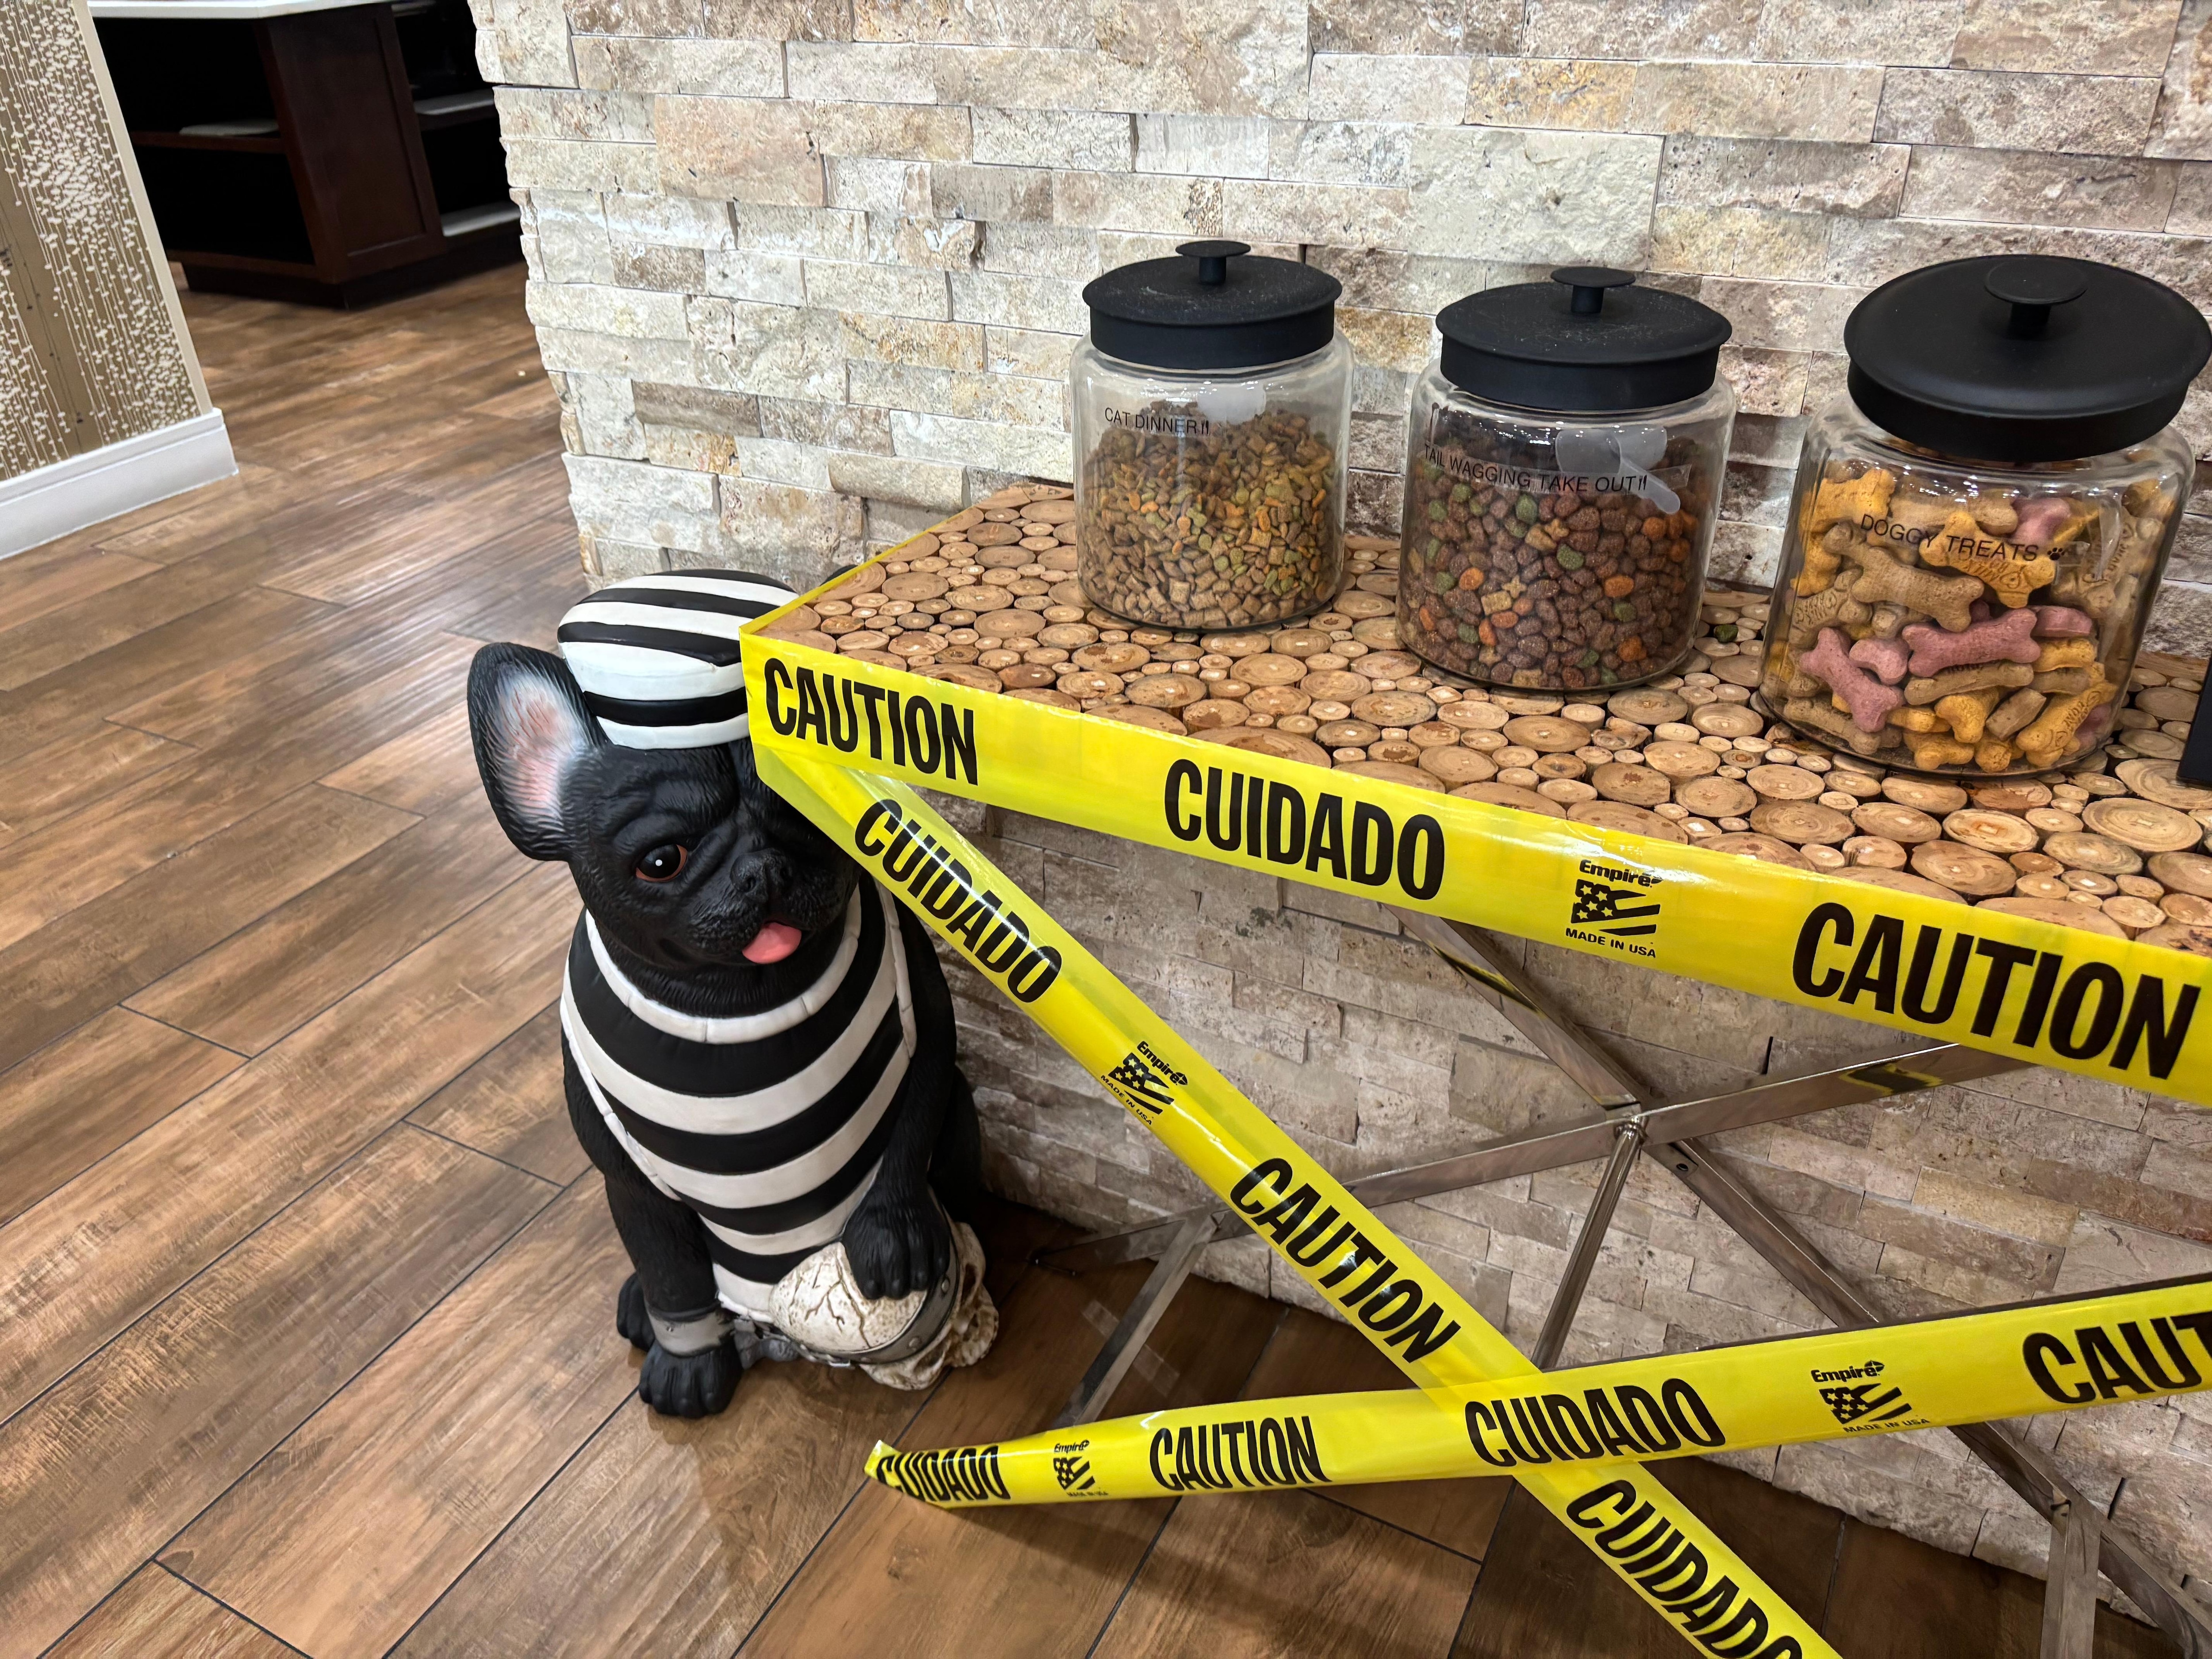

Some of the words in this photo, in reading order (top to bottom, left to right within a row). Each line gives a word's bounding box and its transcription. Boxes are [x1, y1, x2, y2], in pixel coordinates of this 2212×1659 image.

[1105, 407, 1131, 426] CAT
[1135, 414, 1197, 434] DINNER
[1425, 443, 1445, 468] TAIL
[1450, 455, 1531, 488] WAGGING
[1538, 473, 1589, 492] TAKE
[1595, 476, 1636, 492] OUT
[1861, 514, 1939, 548] DOGGY
[1946, 535, 2039, 561] TREATS
[764, 657, 979, 786] CAUTION
[1164, 759, 1444, 900] CUIDADO
[1579, 859, 1653, 887] Empire
[855, 799, 1062, 1003] CUIDADO
[1566, 927, 1606, 945] MADE
[1610, 939, 1624, 950] IN
[1629, 944, 1656, 958] USA
[1792, 902, 2201, 1080] CAUTION
[1137, 1041, 1182, 1085] Empire
[1101, 1075, 1125, 1098] MADE
[1125, 1098, 1136, 1108] IN
[1136, 1108, 1152, 1125] USA
[1230, 1157, 1461, 1363] CAUTION
[1811, 1363, 1879, 1382] Empire
[1464, 1378, 1726, 1467] CUIDADO
[1843, 1424, 1882, 1433] MADE
[876, 1445, 1011, 1502] CUIDADO
[1150, 1416, 1333, 1491] CAUTION
